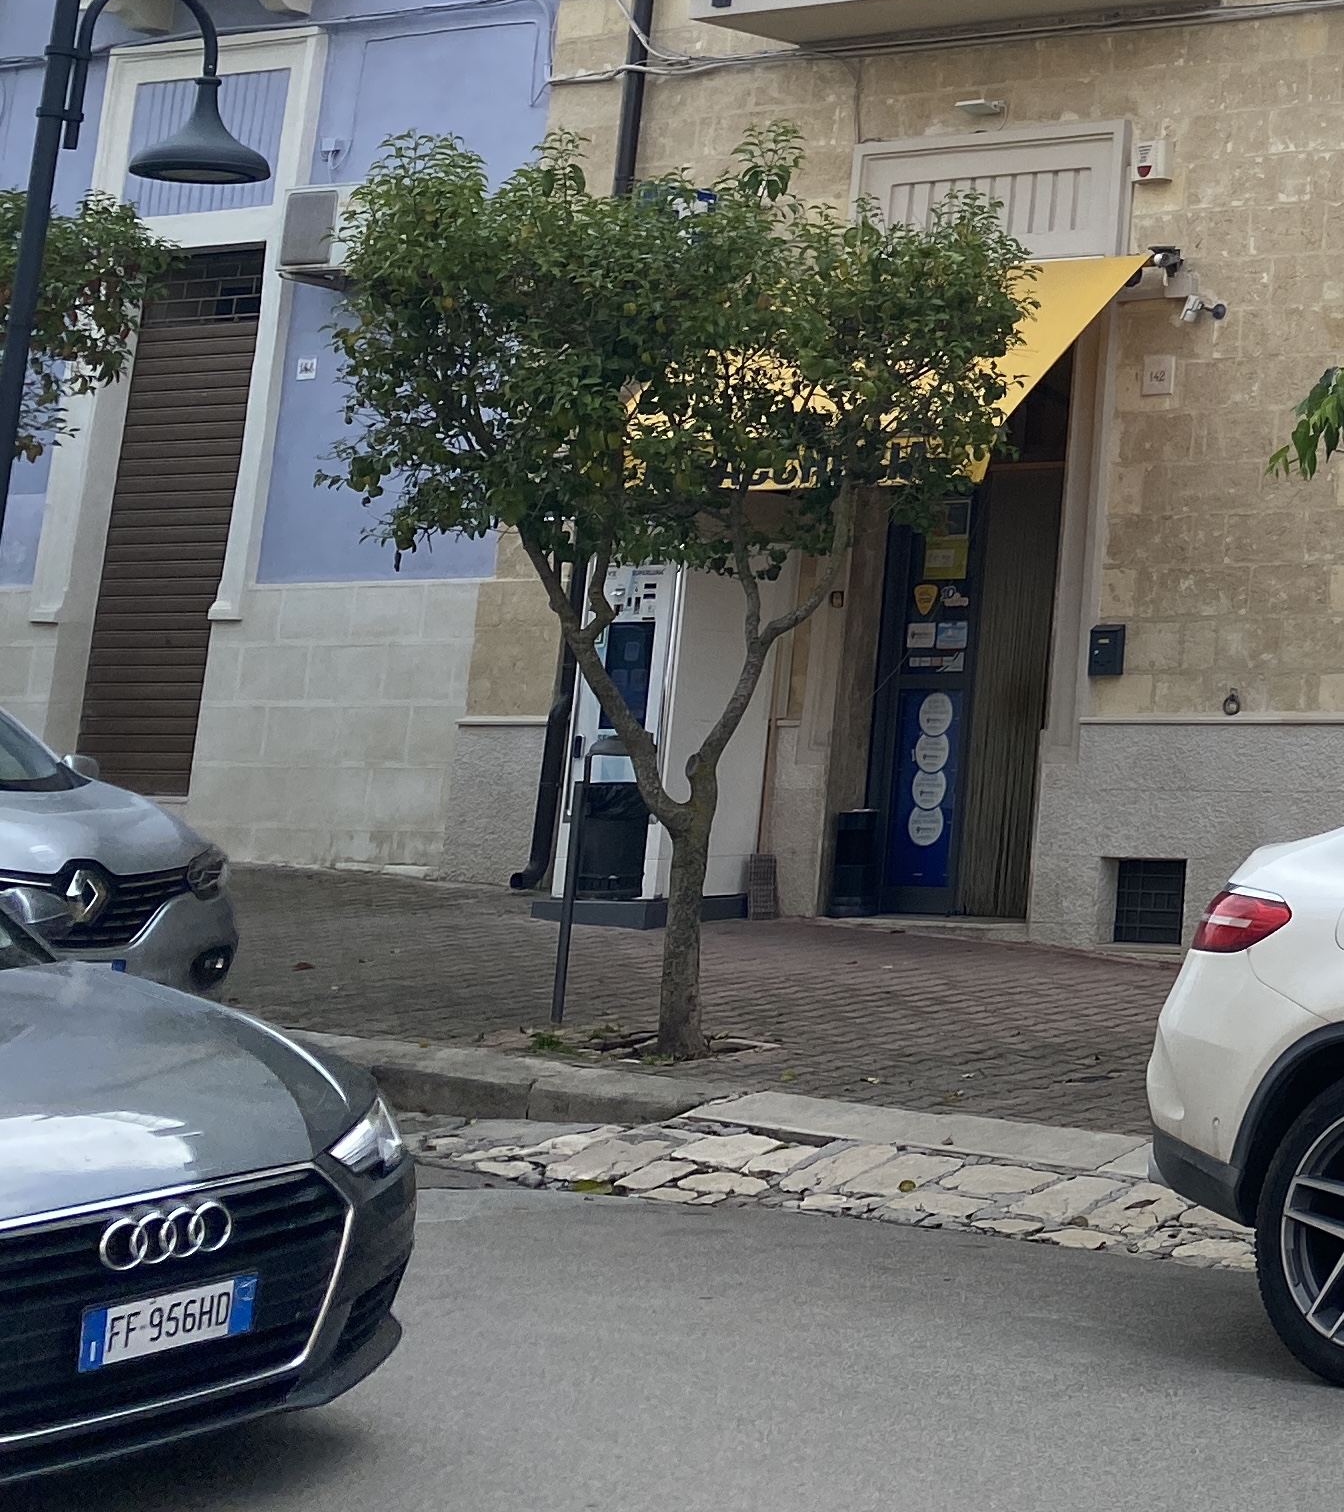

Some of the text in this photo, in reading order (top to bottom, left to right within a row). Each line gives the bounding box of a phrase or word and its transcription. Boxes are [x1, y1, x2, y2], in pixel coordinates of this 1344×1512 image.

[1150, 370, 1165, 382] 142
[107, 1291, 231, 1353] FF 956HD
